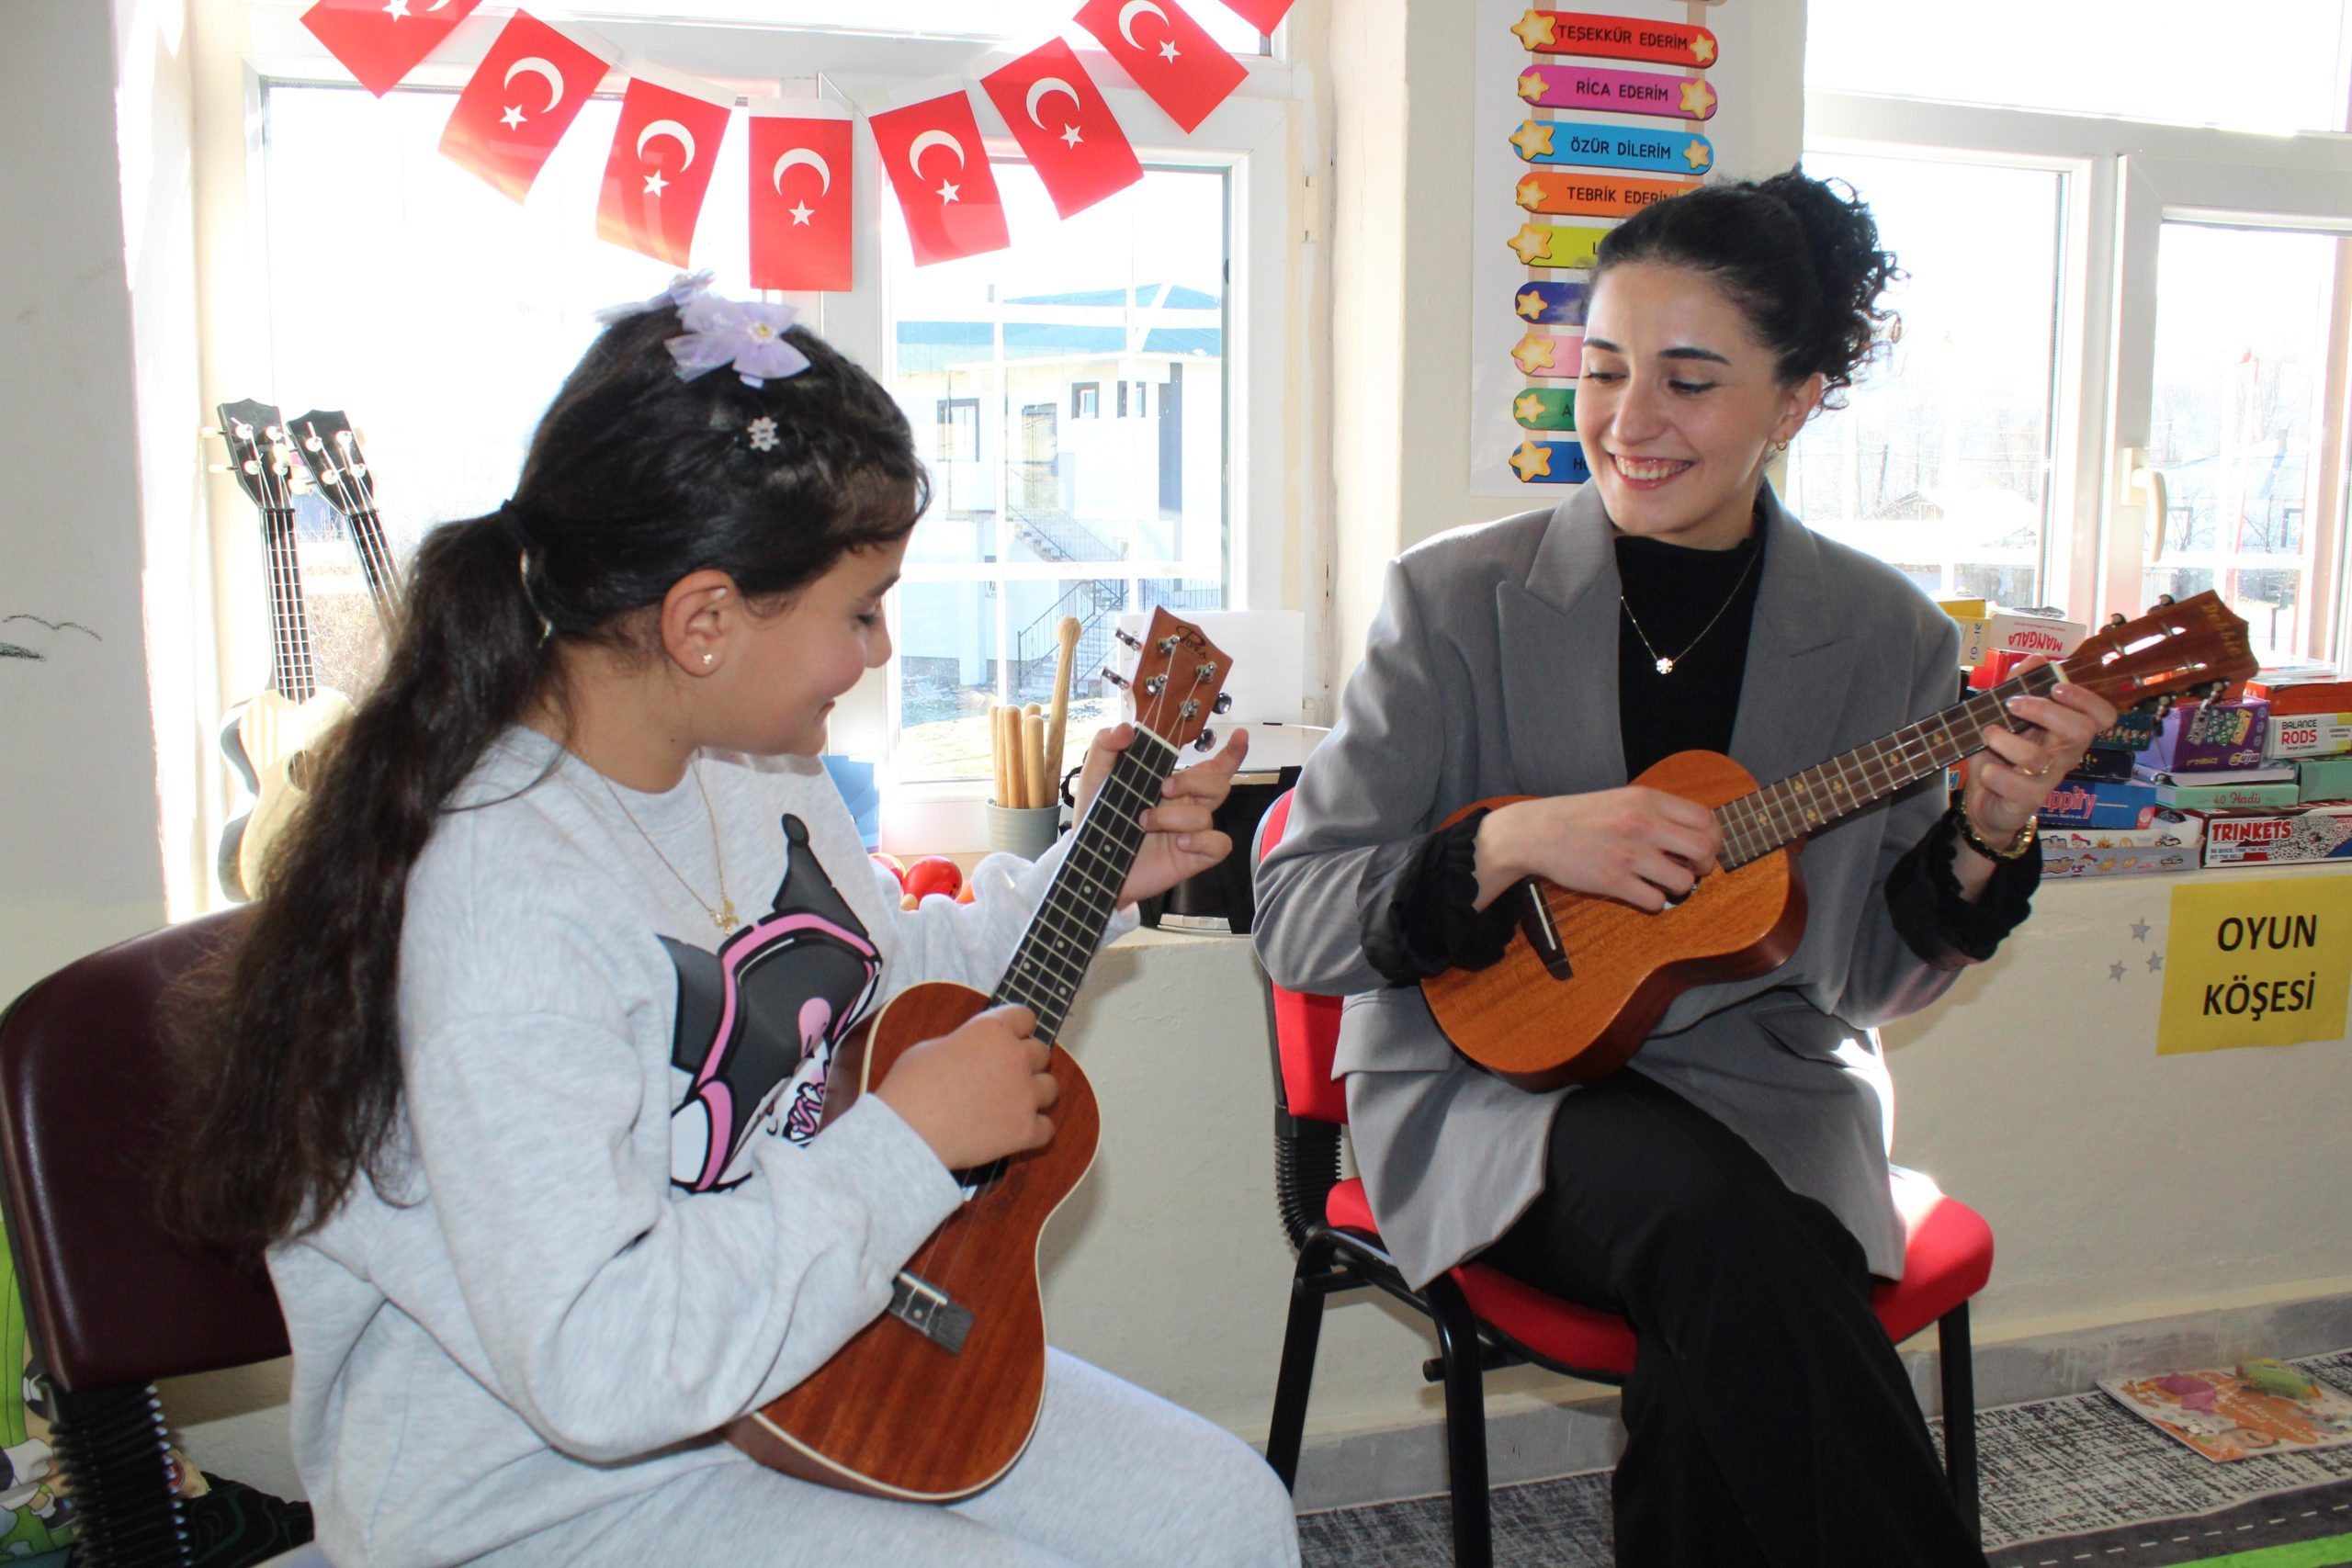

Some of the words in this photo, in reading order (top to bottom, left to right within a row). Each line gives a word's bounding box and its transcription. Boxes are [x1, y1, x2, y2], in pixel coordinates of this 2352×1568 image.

[1558, 25, 1632, 44] TEŞEKKÜR
[1640, 32, 1688, 50] EDERİM
[1576, 78, 1611, 96] RİCA
[1619, 85, 1668, 101] EDERİM
[1570, 137, 1610, 154] ÖZÜR
[1618, 142, 1671, 159] DİLERİM
[1567, 186, 1617, 202] TEBRİK
[2007, 631, 2063, 652] MANGALA
[2282, 719, 2317, 729] BALANCE
[2281, 729, 2317, 744] RODS
[2041, 785, 2098, 819] ppity
[2211, 820, 2292, 842] TRINKETS
[2217, 915, 2317, 952] OYUN
[2203, 971, 2316, 1021] KÖŞESİ
